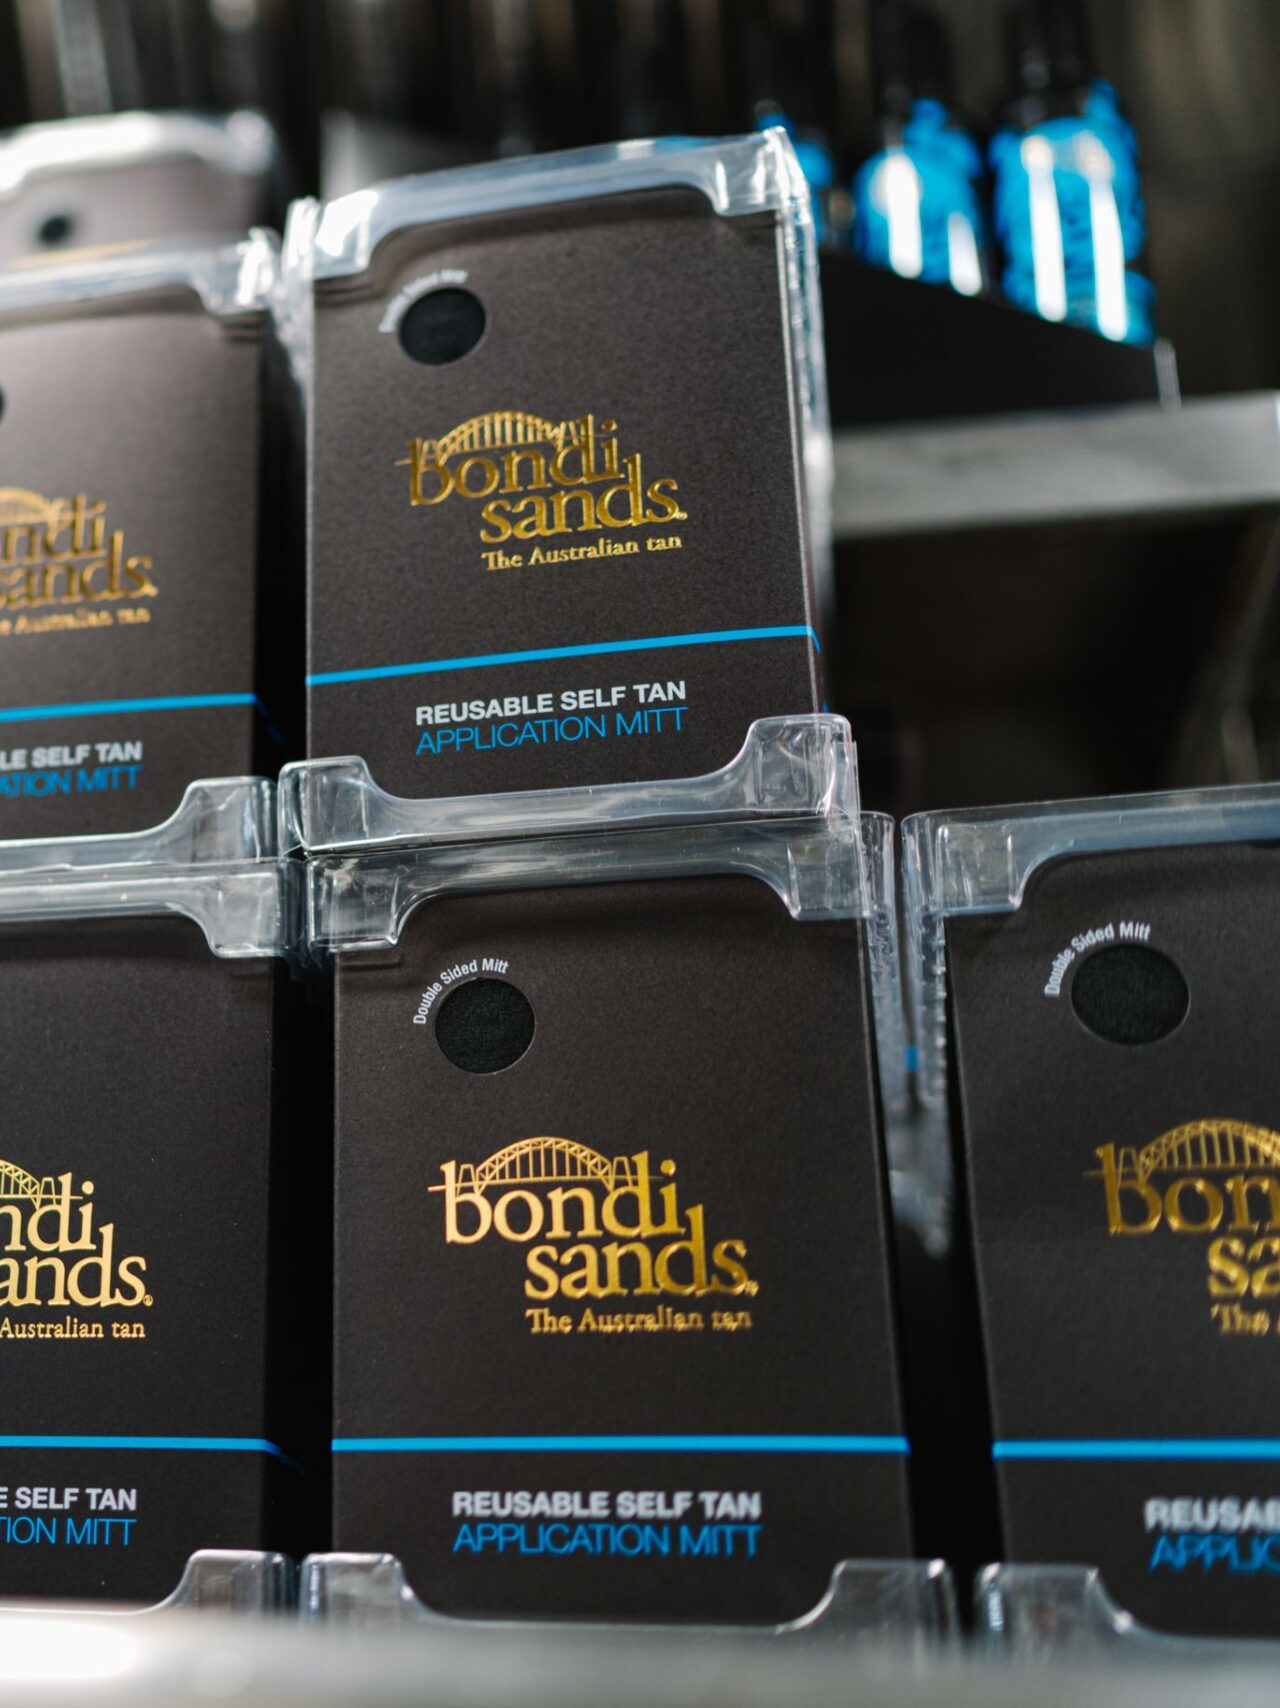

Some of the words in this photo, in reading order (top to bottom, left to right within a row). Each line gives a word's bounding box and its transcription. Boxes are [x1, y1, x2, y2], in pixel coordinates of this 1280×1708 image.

[406, 413, 625, 507] bondi
[479, 453, 681, 543] sands
[480, 549, 523, 571] The
[527, 537, 640, 566] Australian
[645, 534, 683, 552] tan
[415, 693, 554, 726] REUSABLE
[560, 686, 626, 711] SELF
[632, 680, 687, 704] TAN
[415, 713, 608, 756] APPLICATION
[615, 706, 688, 737] MITT
[31, 744, 90, 769] SELF
[94, 740, 143, 764] TAN
[76, 764, 143, 794] MITT
[1044, 948, 1075, 998] Double
[1071, 922, 1115, 953] Sided
[1119, 920, 1151, 942] Mitt
[412, 982, 443, 1025] Double
[440, 959, 478, 985] Sided
[481, 958, 509, 974] Mitt
[440, 1150, 685, 1245] bondi
[524, 1204, 749, 1300] sands
[111, 1319, 146, 1339] tan
[524, 1306, 573, 1335] The
[577, 1305, 704, 1333] Australian
[711, 1308, 753, 1332] tan
[14, 1486, 80, 1510] SELF
[85, 1487, 138, 1511] TAN
[451, 1490, 611, 1518] REUSABLE
[616, 1490, 694, 1519] SELF
[698, 1491, 763, 1521] TAN
[65, 1517, 138, 1546] MITT
[452, 1522, 670, 1556] APPLICATION
[679, 1524, 763, 1557] MITT
